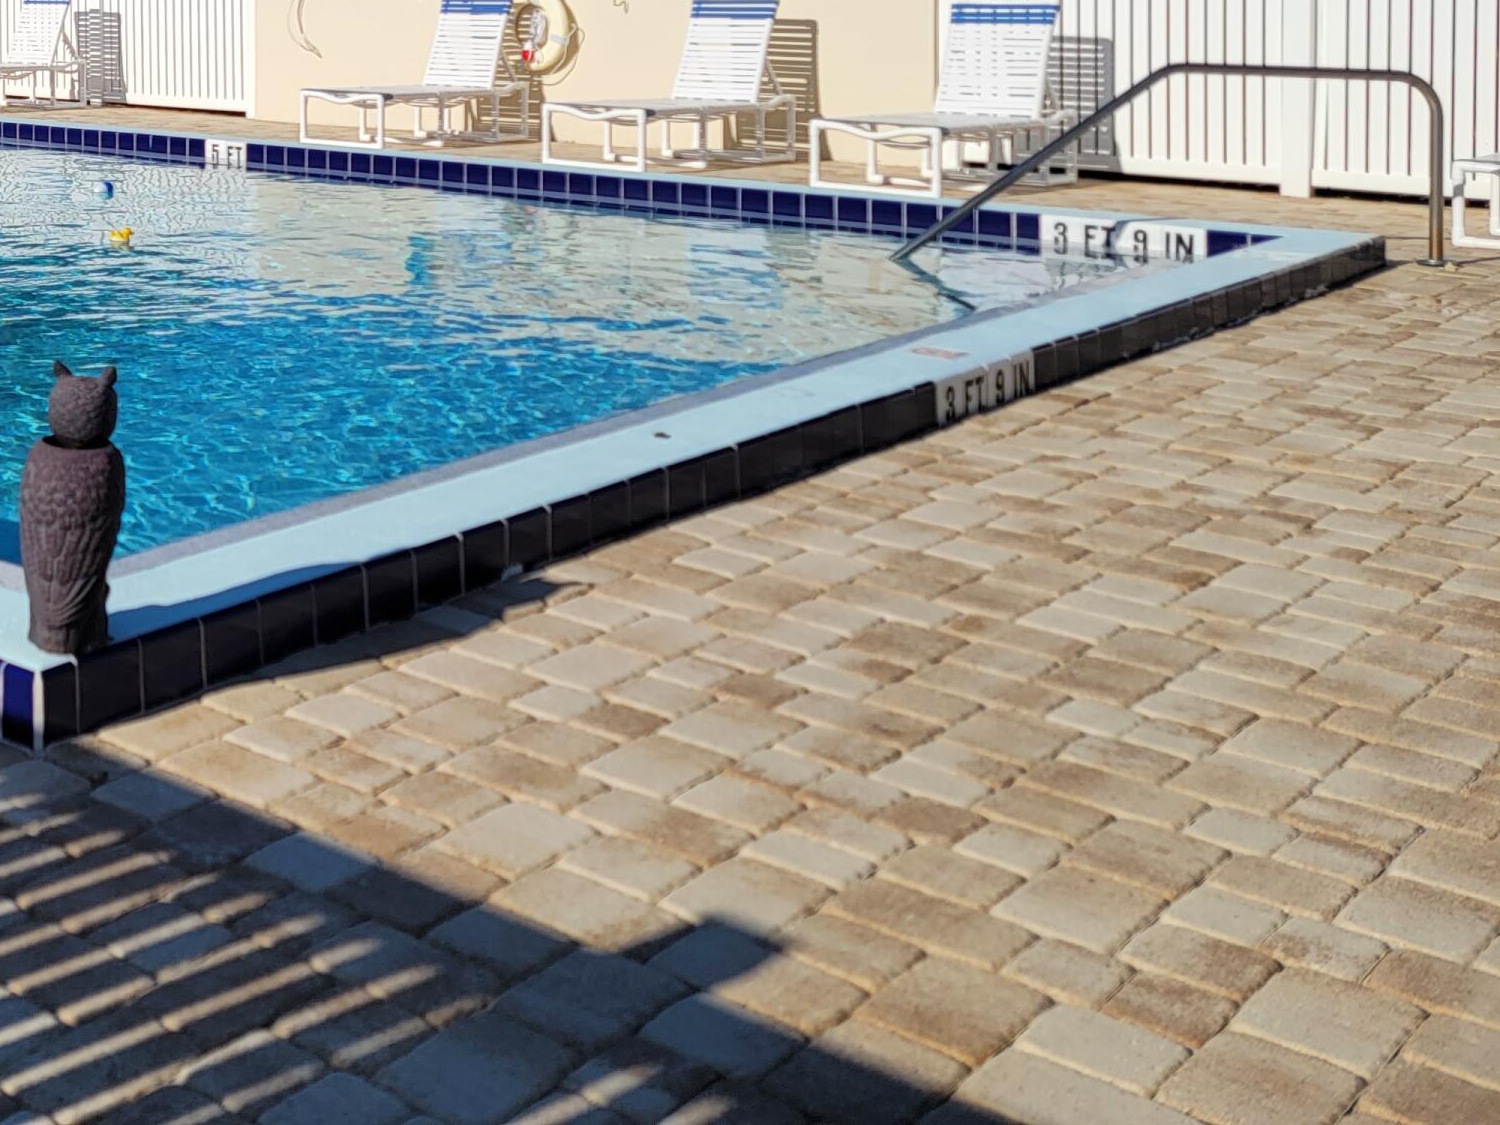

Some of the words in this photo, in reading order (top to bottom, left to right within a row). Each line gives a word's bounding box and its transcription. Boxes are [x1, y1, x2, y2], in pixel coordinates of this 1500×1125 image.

[211, 144, 219, 169] 5
[227, 145, 243, 169] FT
[1053, 222, 1068, 255] 3
[1084, 225, 1116, 258] FT
[1133, 229, 1148, 263] 9
[1165, 232, 1195, 263] IN
[946, 385, 957, 422] 3
[995, 368, 1005, 406] 9
